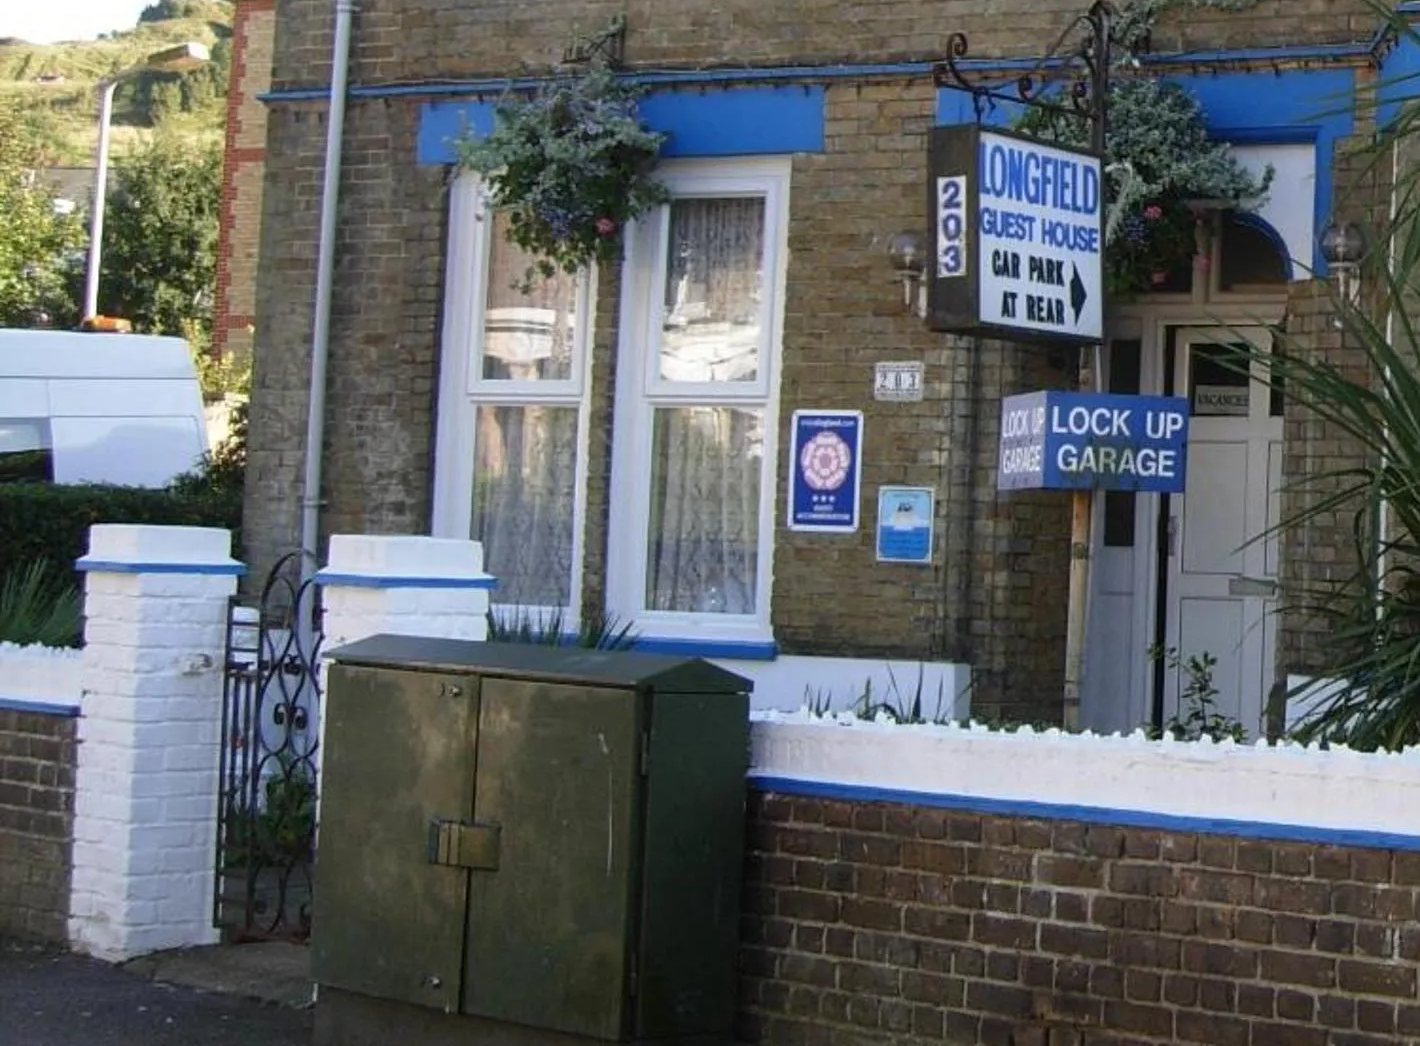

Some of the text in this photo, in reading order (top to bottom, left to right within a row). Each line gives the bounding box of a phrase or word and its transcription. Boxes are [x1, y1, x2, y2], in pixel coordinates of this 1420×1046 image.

[979, 141, 1098, 215] LONGFIELD
[942, 180, 962, 273] 203
[980, 207, 1099, 253] GUEST HOUSE
[992, 249, 1065, 287] CAR PARK
[1001, 291, 1065, 325] AT REAR
[1002, 406, 1046, 438] LOCK UP
[1052, 405, 1184, 440] LOCK UP
[1003, 445, 1041, 474] GARAGE
[1057, 444, 1176, 478] GARAGE
